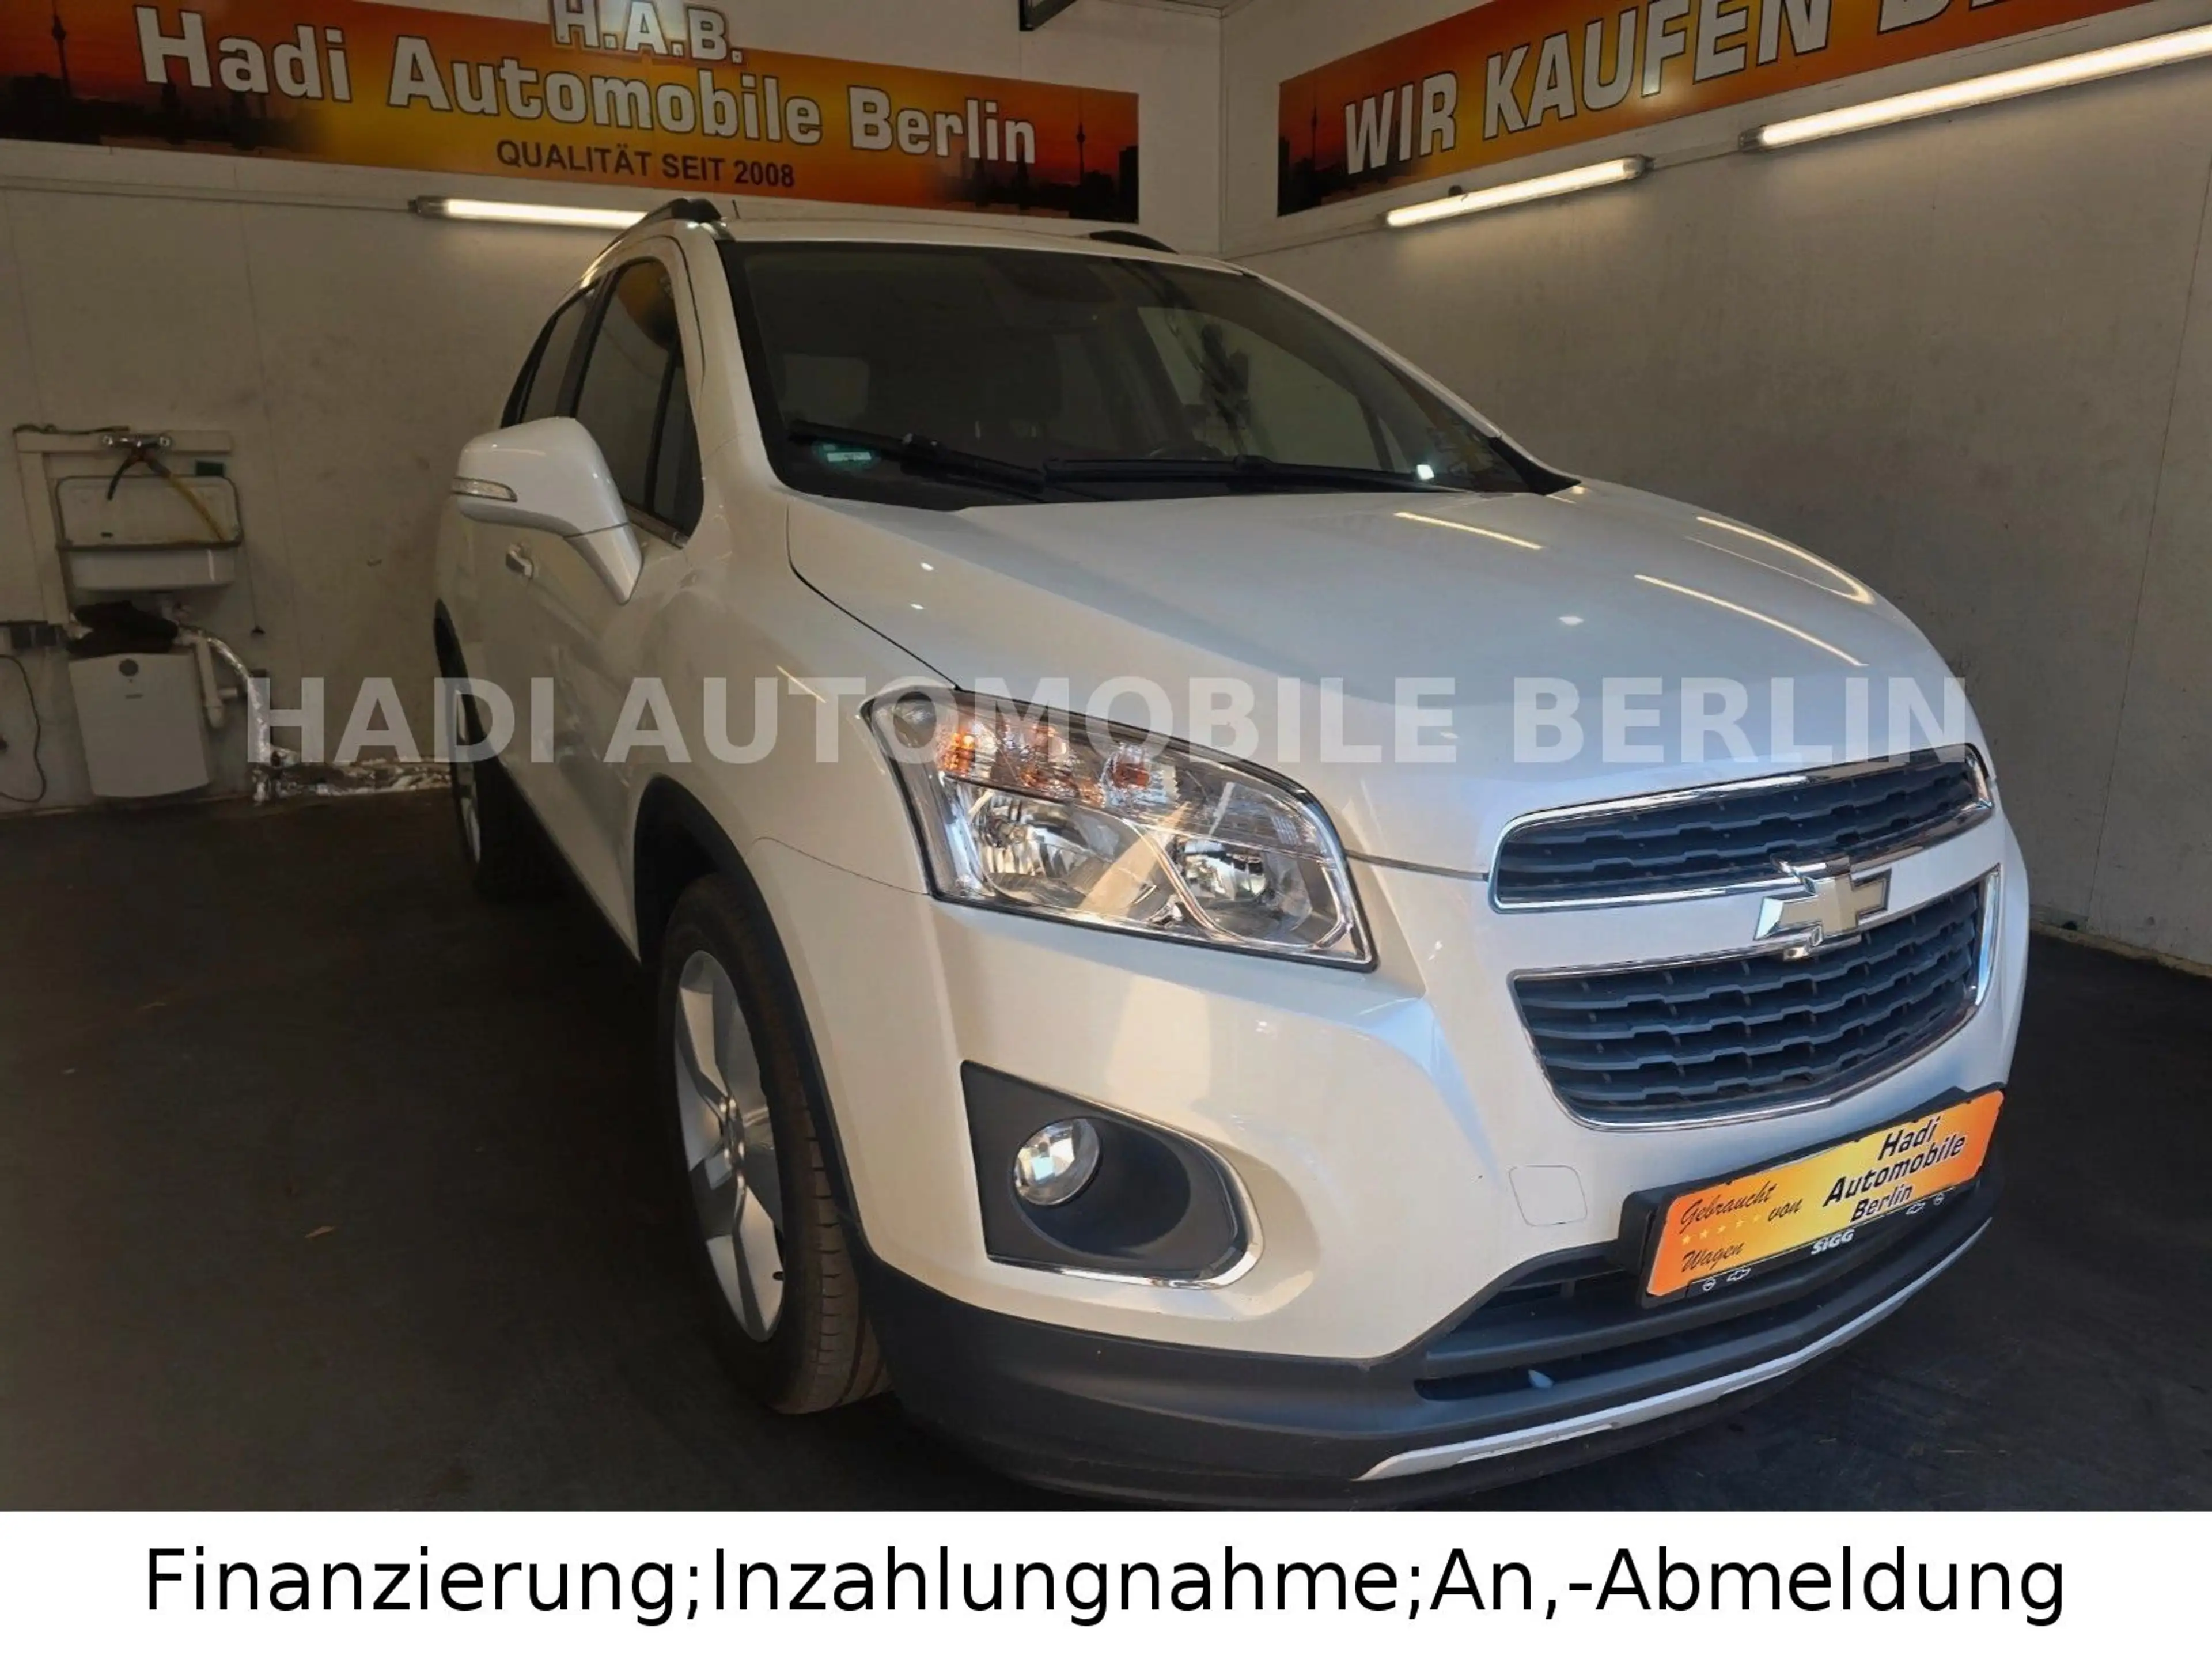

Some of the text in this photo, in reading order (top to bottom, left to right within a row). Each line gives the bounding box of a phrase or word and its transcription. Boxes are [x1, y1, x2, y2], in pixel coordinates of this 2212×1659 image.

[133, 6, 1037, 164] Hadi Automobile Berlin
[1344, 0, 1833, 175] WIR KAUFEN
[497, 140, 796, 187] QUALITÄT SEIT 2008
[1878, 1115, 1942, 1161] Hadi
[1822, 1134, 1966, 1207] Automobile
[1679, 1180, 1777, 1234] Gebraucht
[1768, 1198, 1803, 1222] von
[1850, 1184, 1913, 1222] Berlin
[1681, 1242, 1744, 1272] Wagen
